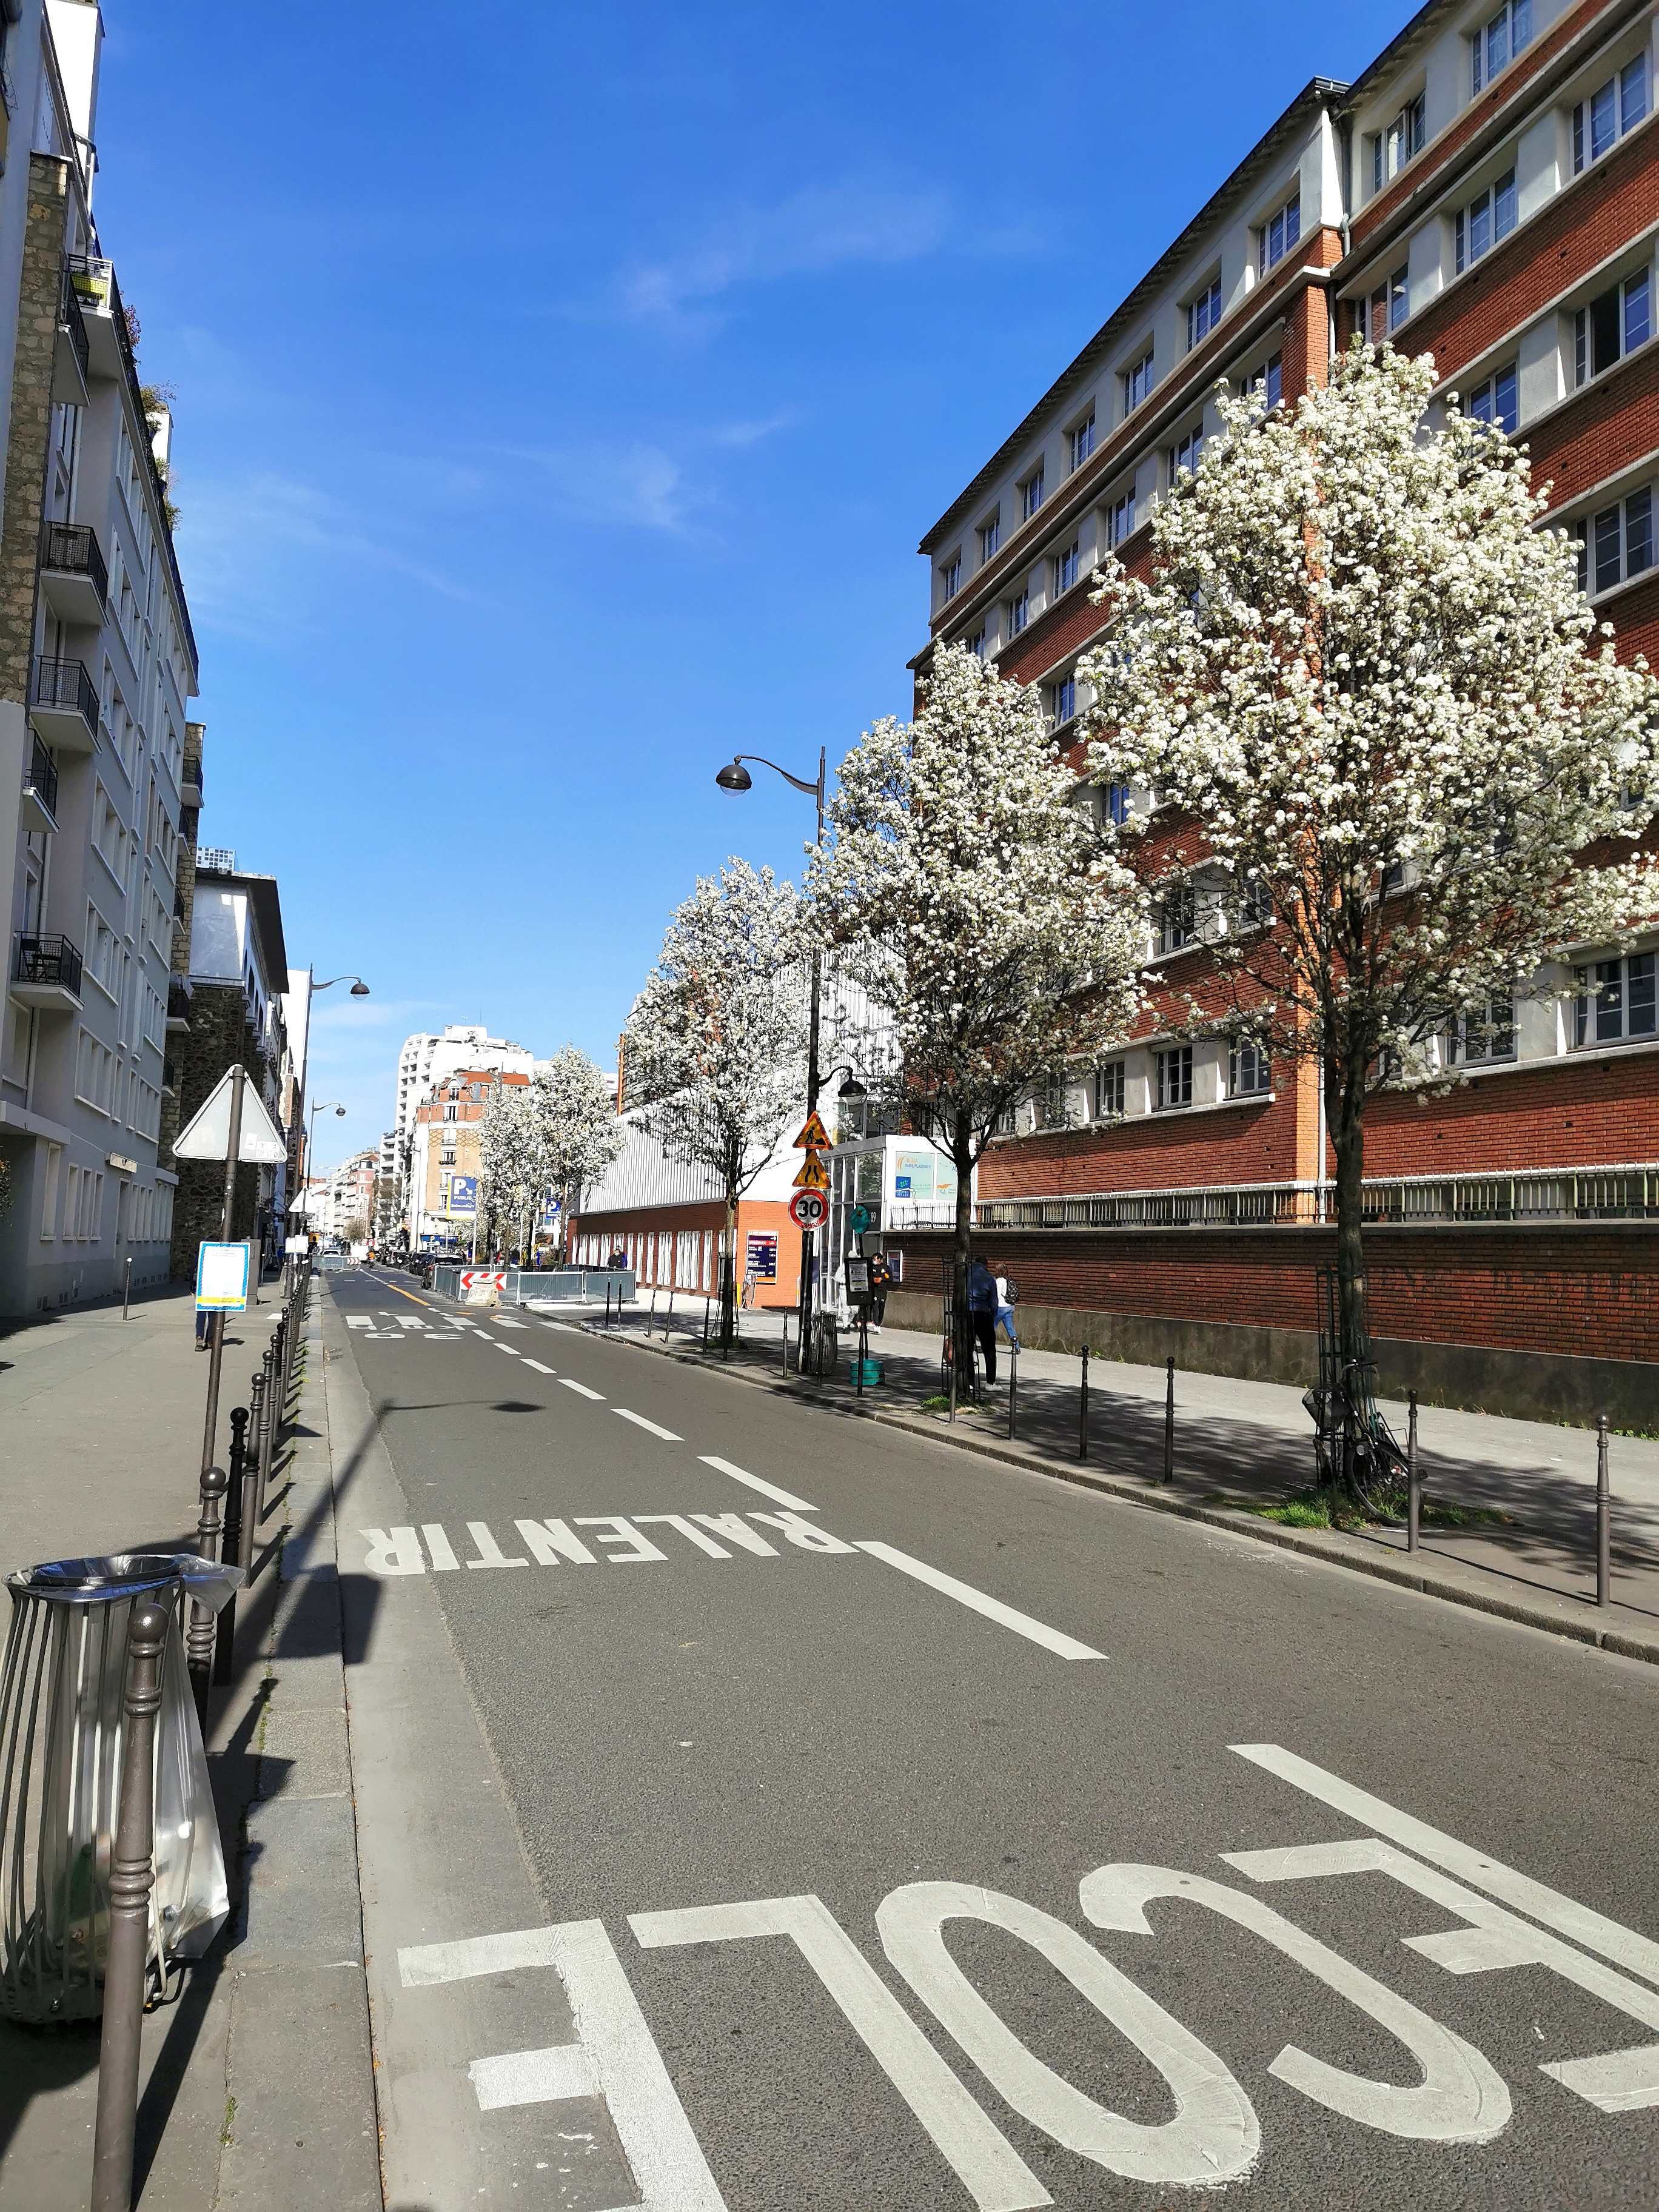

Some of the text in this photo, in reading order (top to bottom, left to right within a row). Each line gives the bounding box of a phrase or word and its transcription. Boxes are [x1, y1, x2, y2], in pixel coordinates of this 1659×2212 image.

[454, 1178, 466, 1195] P
[548, 1201, 557, 1213] P
[798, 1200, 822, 1218] 30
[358, 1512, 860, 1575] RALENTIR
[397, 1838, 1659, 2212] ECOLE
